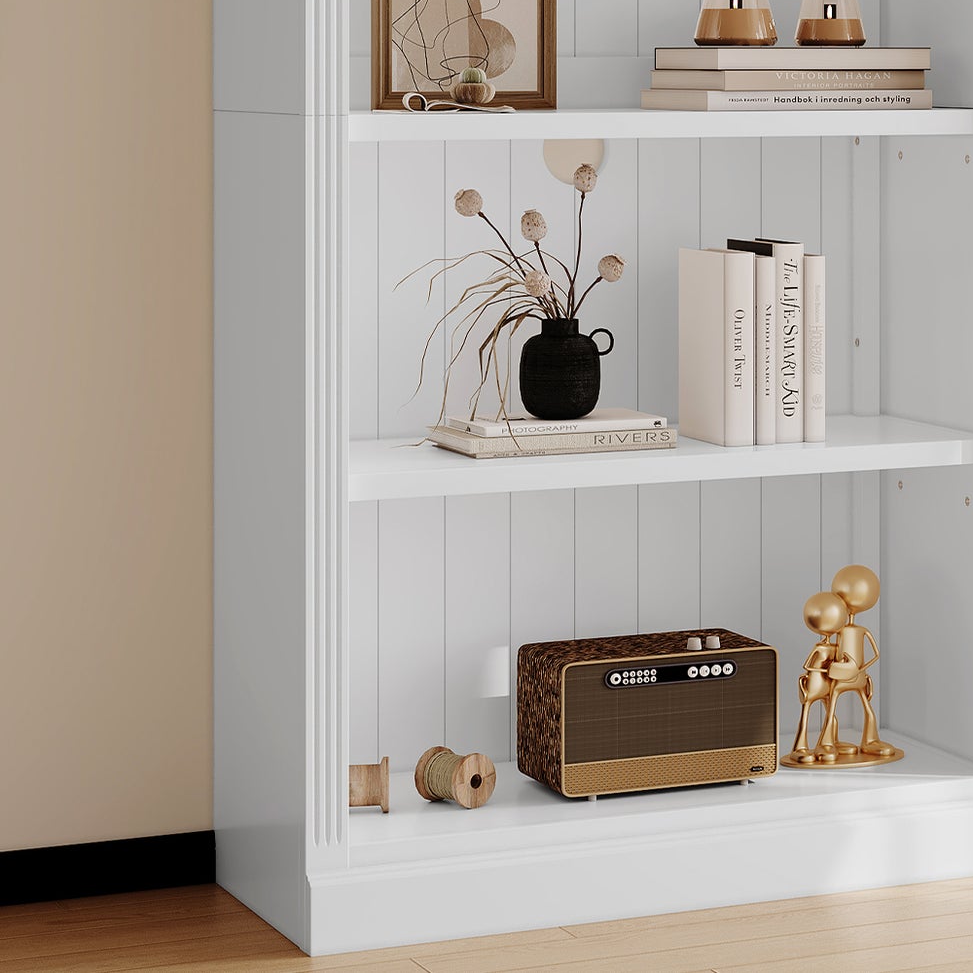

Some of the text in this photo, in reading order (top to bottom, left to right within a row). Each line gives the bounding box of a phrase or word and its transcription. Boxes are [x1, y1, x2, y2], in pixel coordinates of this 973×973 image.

[776, 72, 892, 80] VICTORIA HAGAN
[774, 96, 813, 104] Handbok
[820, 96, 862, 104] inredning
[882, 95, 912, 104] styling
[784, 259, 798, 284] The
[734, 309, 746, 389] OLIVER TWIST
[501, 424, 578, 435] PHOTOGRAPHY
[594, 431, 671, 445] RIVERS
